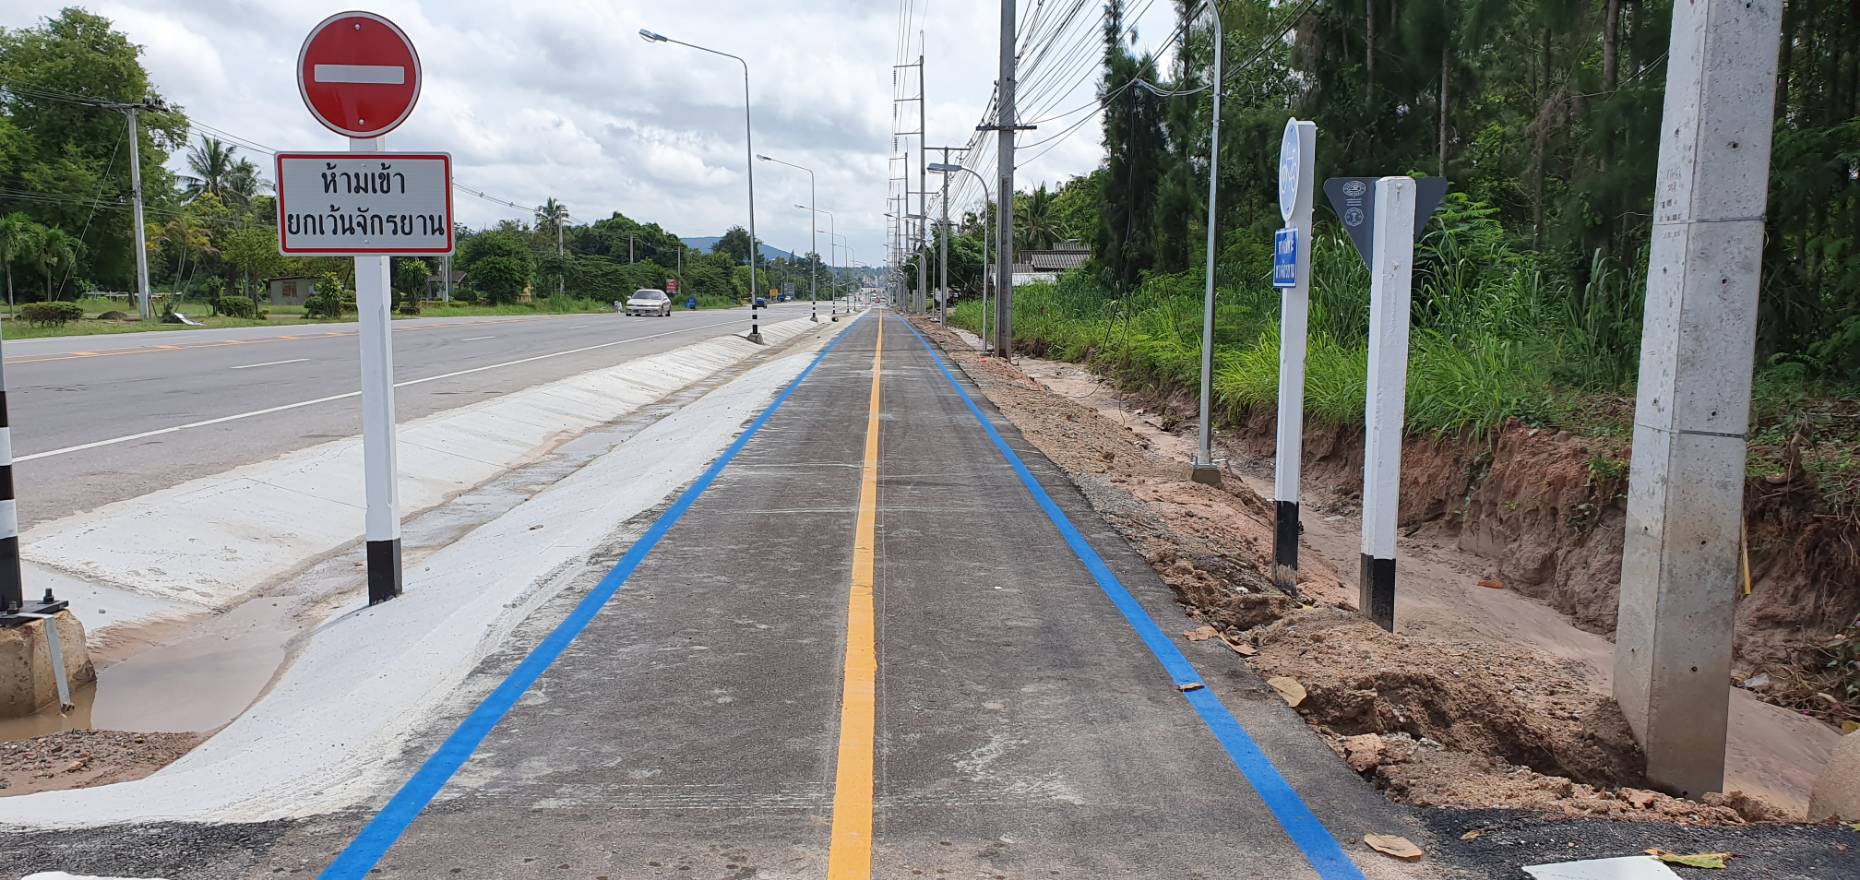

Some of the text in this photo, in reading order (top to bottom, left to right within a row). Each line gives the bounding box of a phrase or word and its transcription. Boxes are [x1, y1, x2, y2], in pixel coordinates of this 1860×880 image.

[321, 162, 405, 194] ห้ามเข้า
[287, 204, 445, 236] ยกเว้นจักรยาน
